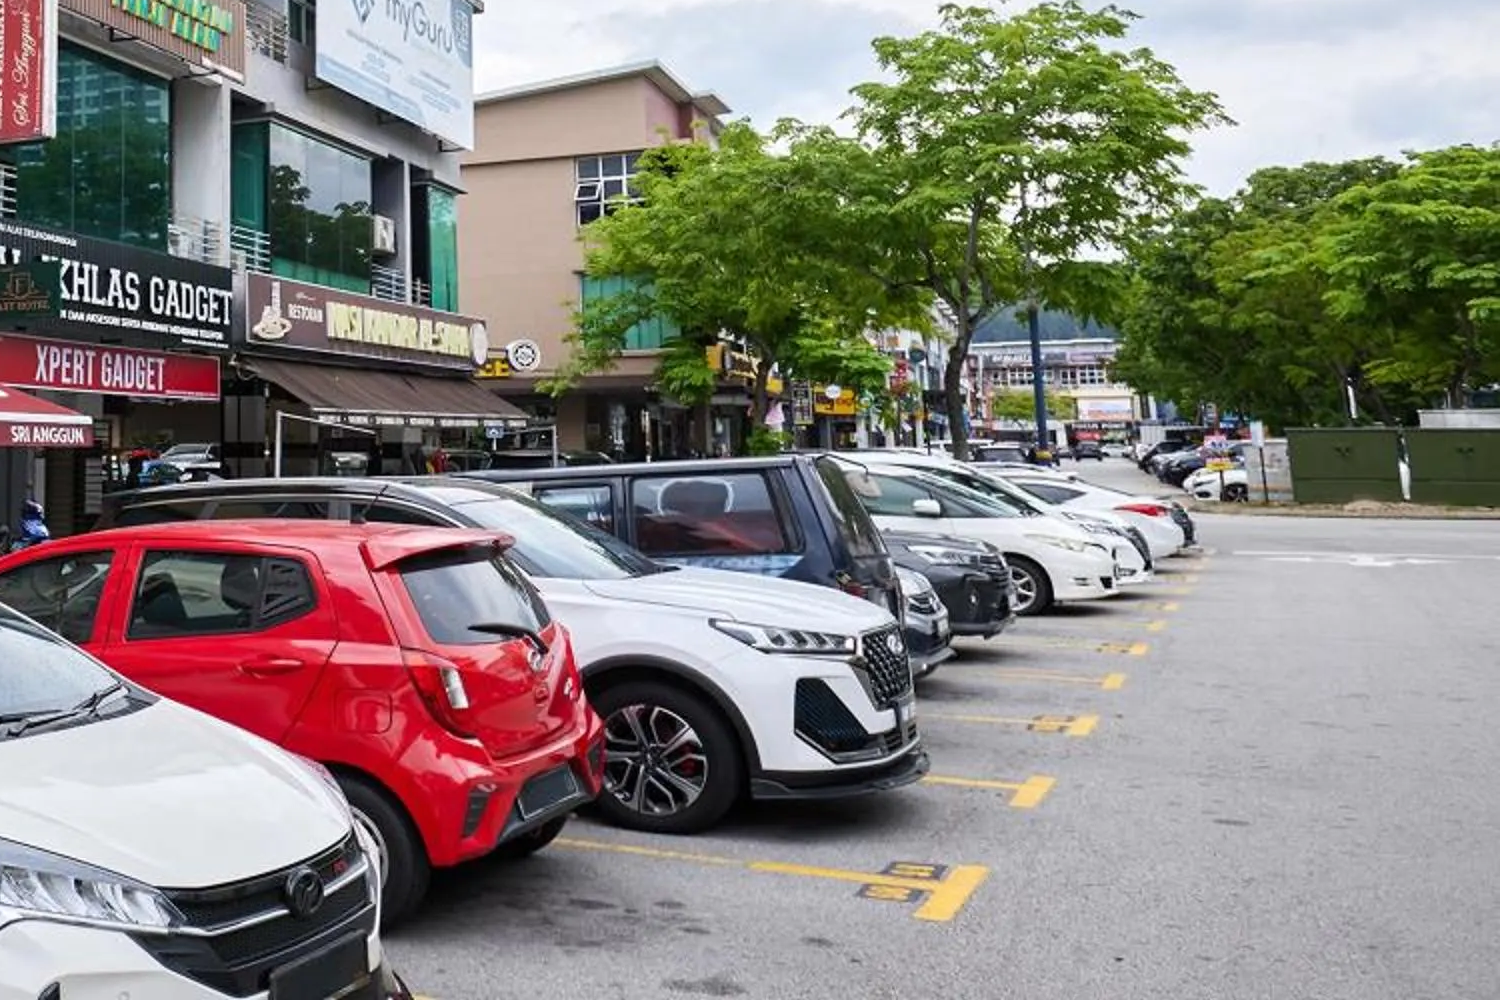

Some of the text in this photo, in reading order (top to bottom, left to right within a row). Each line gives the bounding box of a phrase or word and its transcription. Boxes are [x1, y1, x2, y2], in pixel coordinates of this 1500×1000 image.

[11, 13, 37, 126] Sri Anggun
[150, 276, 233, 326] GADGET
[35, 344, 165, 391] XPERT GADGET
[11, 425, 85, 444] SRI ANGGUN
